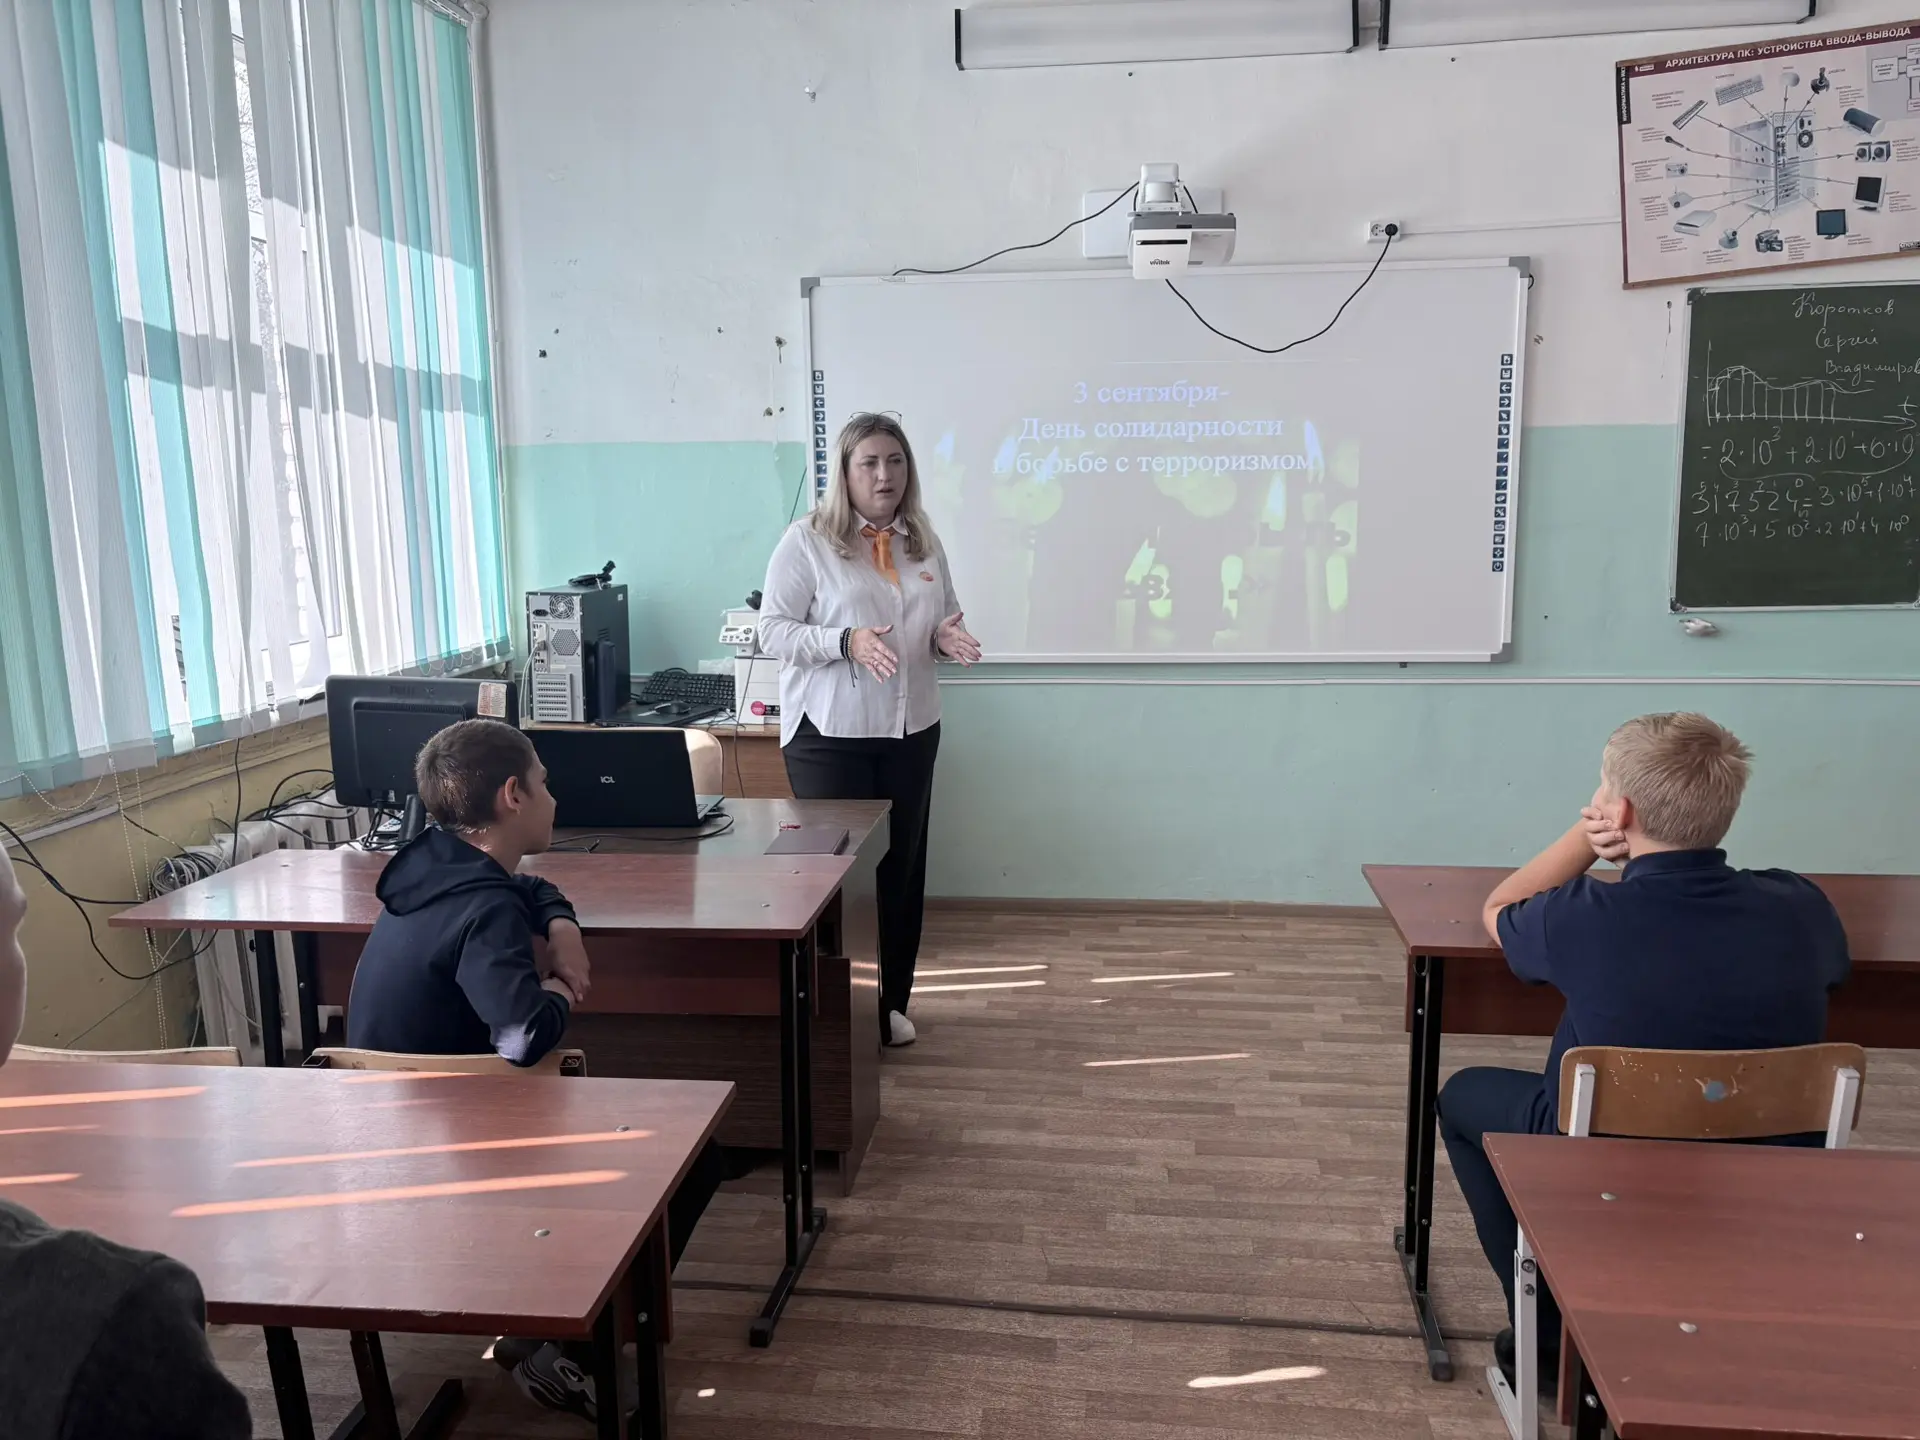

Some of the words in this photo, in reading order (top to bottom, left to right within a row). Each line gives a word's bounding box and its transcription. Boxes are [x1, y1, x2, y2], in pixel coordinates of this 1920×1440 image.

[1665, 50, 1735, 69] АРХИТЕКТУРА
[1737, 49, 1755, 59] ПК:
[1826, 27, 1911, 46] ВВОДА-ВЫВОДА
[1791, 291, 1895, 327] Коротков
[1074, 381, 1088, 404] 3
[1097, 380, 1231, 407] сентября-
[1018, 417, 1087, 443] День
[1094, 417, 1286, 443] солидарности
[1115, 457, 1130, 473] с
[599, 775, 616, 784] ICL
